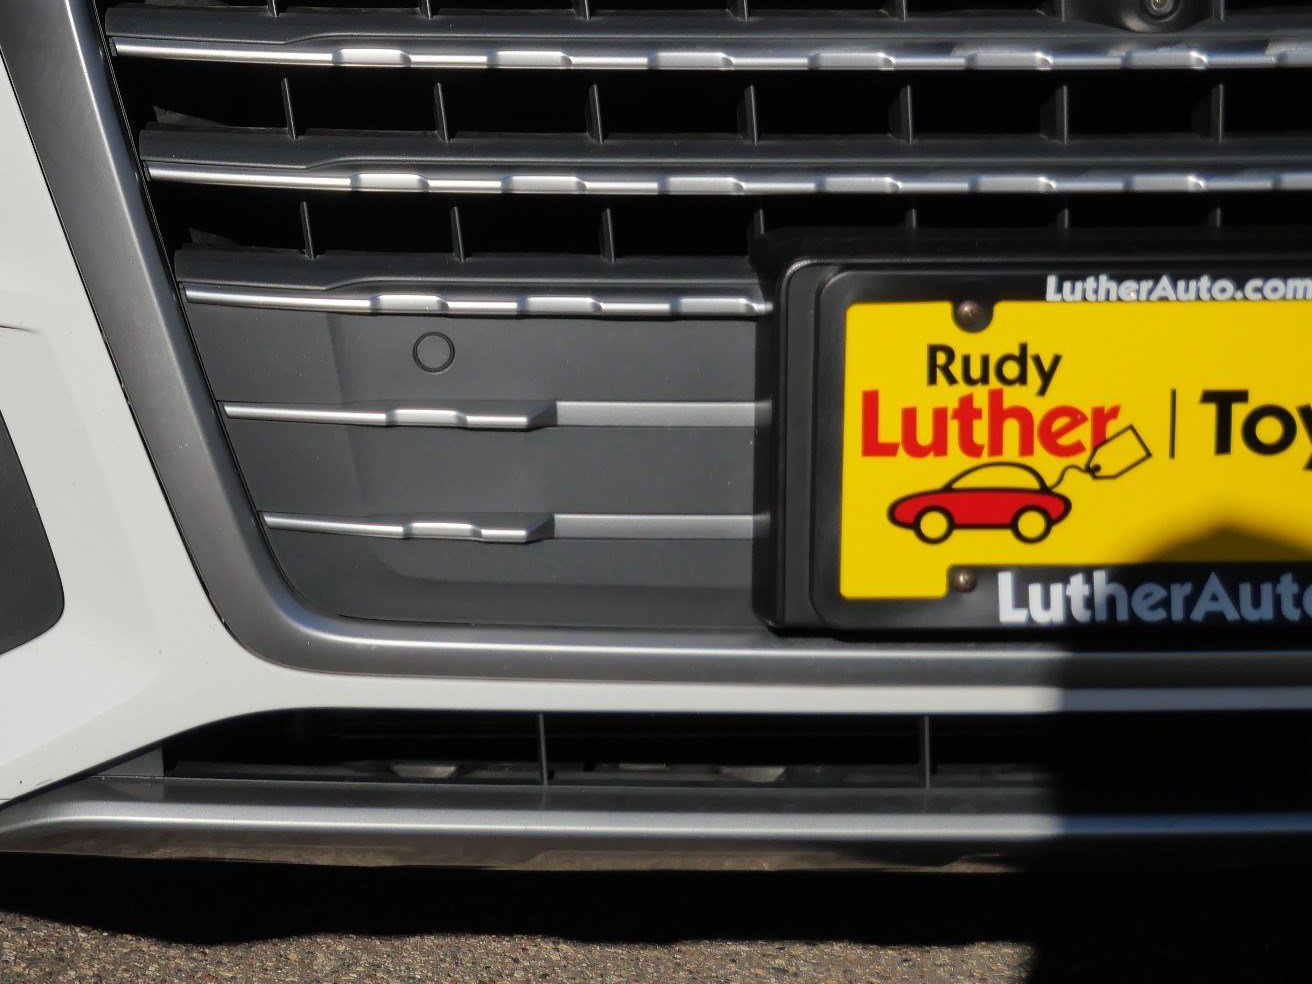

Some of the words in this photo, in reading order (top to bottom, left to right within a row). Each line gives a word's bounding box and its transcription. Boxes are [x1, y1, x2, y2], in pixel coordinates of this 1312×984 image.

[1045, 274, 1312, 302] LutherAuto.com
[926, 343, 1062, 396] Rudy
[860, 388, 1121, 459] Luther
[997, 571, 1312, 624] LutherAut
